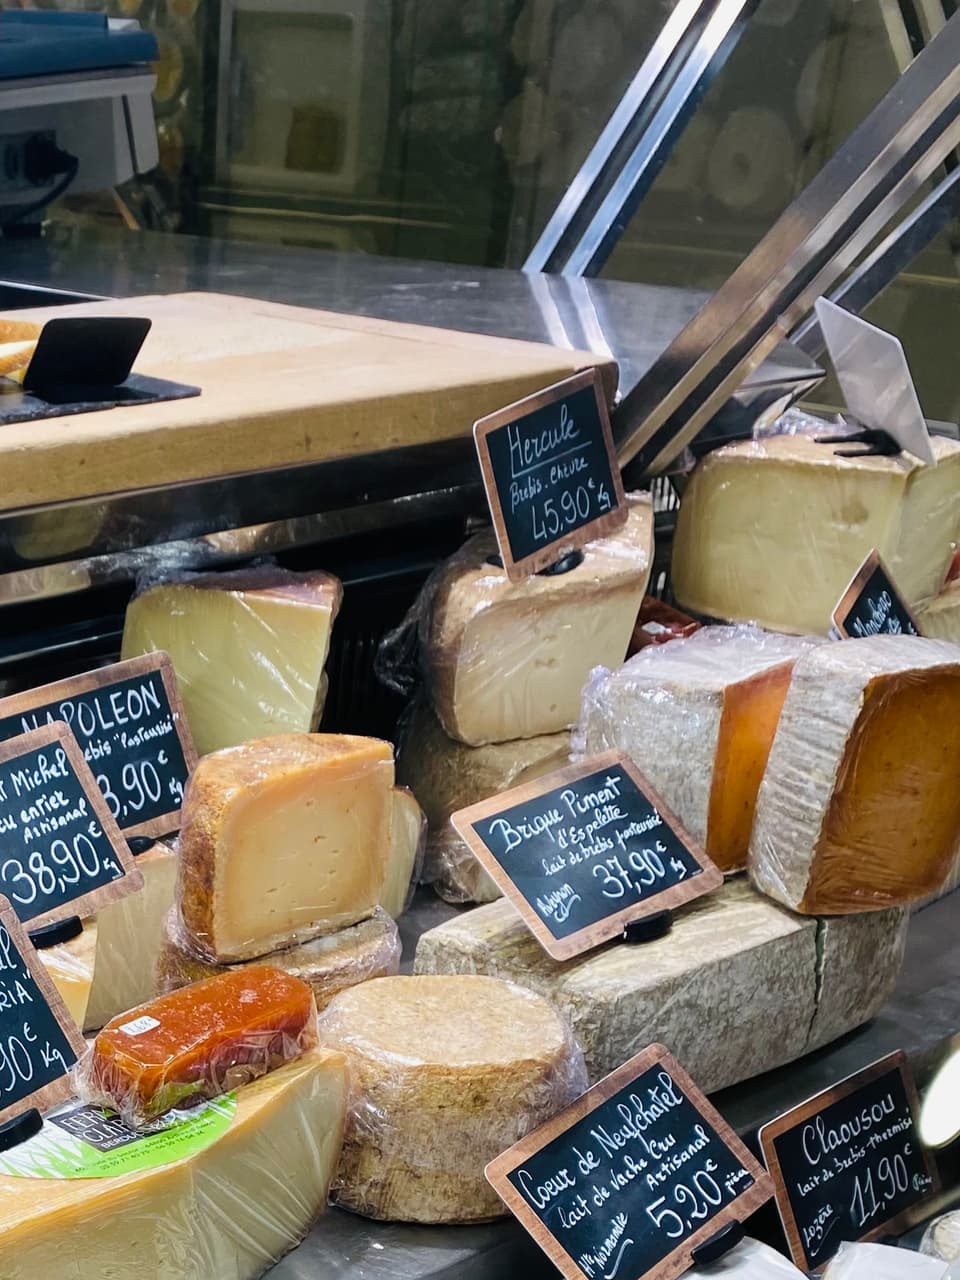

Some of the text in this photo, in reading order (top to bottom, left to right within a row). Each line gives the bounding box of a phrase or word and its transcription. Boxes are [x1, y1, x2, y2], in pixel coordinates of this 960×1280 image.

[507, 404, 580, 468] Hercule
[10, 748, 70, 798] Michel
[489, 776, 622, 855] Brique Piment
[573, 1147, 601, 1177] de
[646, 1124, 711, 1191] Artisanal
[559, 1196, 592, 1229] lait
[593, 1185, 611, 1208] de
[797, 1175, 821, 1197] lait
